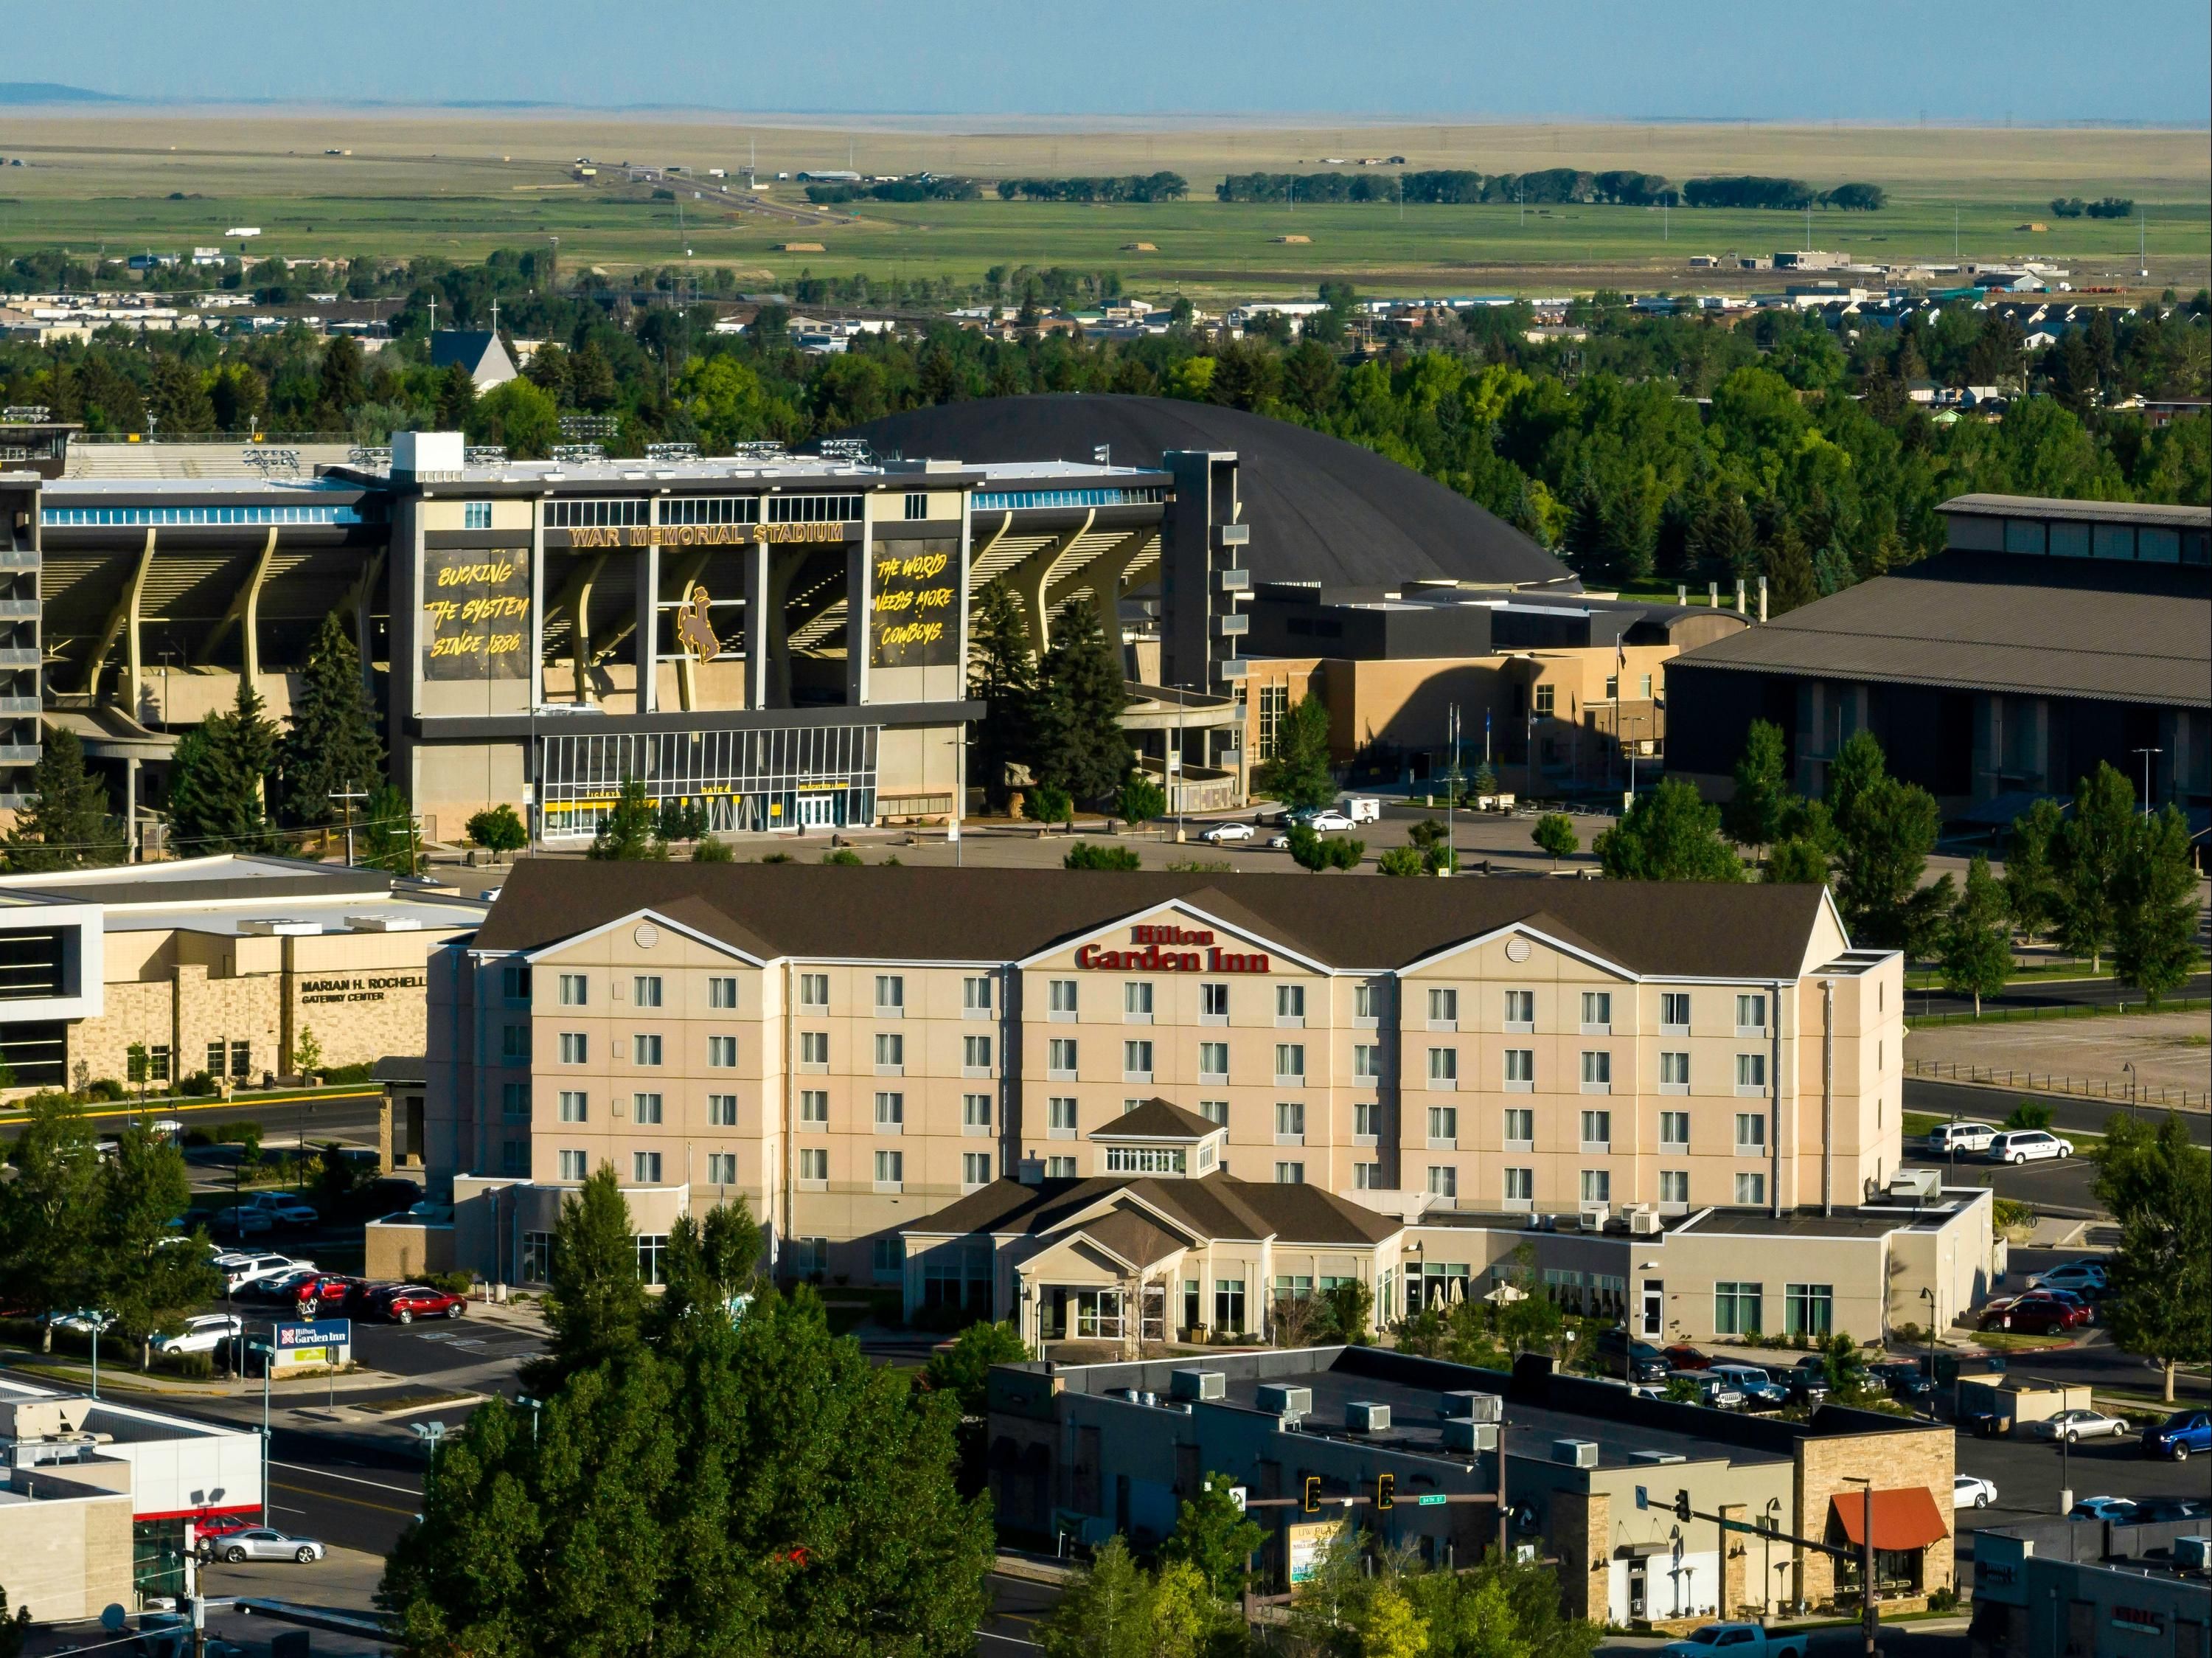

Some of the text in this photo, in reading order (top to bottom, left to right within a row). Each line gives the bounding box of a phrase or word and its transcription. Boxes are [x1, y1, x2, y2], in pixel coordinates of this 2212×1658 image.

[569, 523, 844, 547] WAR MEMORIAL STADIUM
[438, 556, 512, 586] BUCKING
[877, 553, 947, 585] THE WORLD
[875, 588, 955, 612] NEEDS MORE
[424, 597, 529, 631] THE SYSTEM
[430, 629, 485, 657] SINCE
[882, 622, 943, 645] COWBOYS.
[700, 783, 731, 794] GATE 4
[1130, 925, 1215, 946] Hilton
[1074, 944, 1271, 973] Garden Inn
[302, 977, 428, 992] MARIAN H. ROCHELL
[302, 993, 384, 1004] GATEWAY CENTER
[295, 1332, 346, 1344] Garden Inn
[1315, 1523, 1343, 1535] PLAZ
